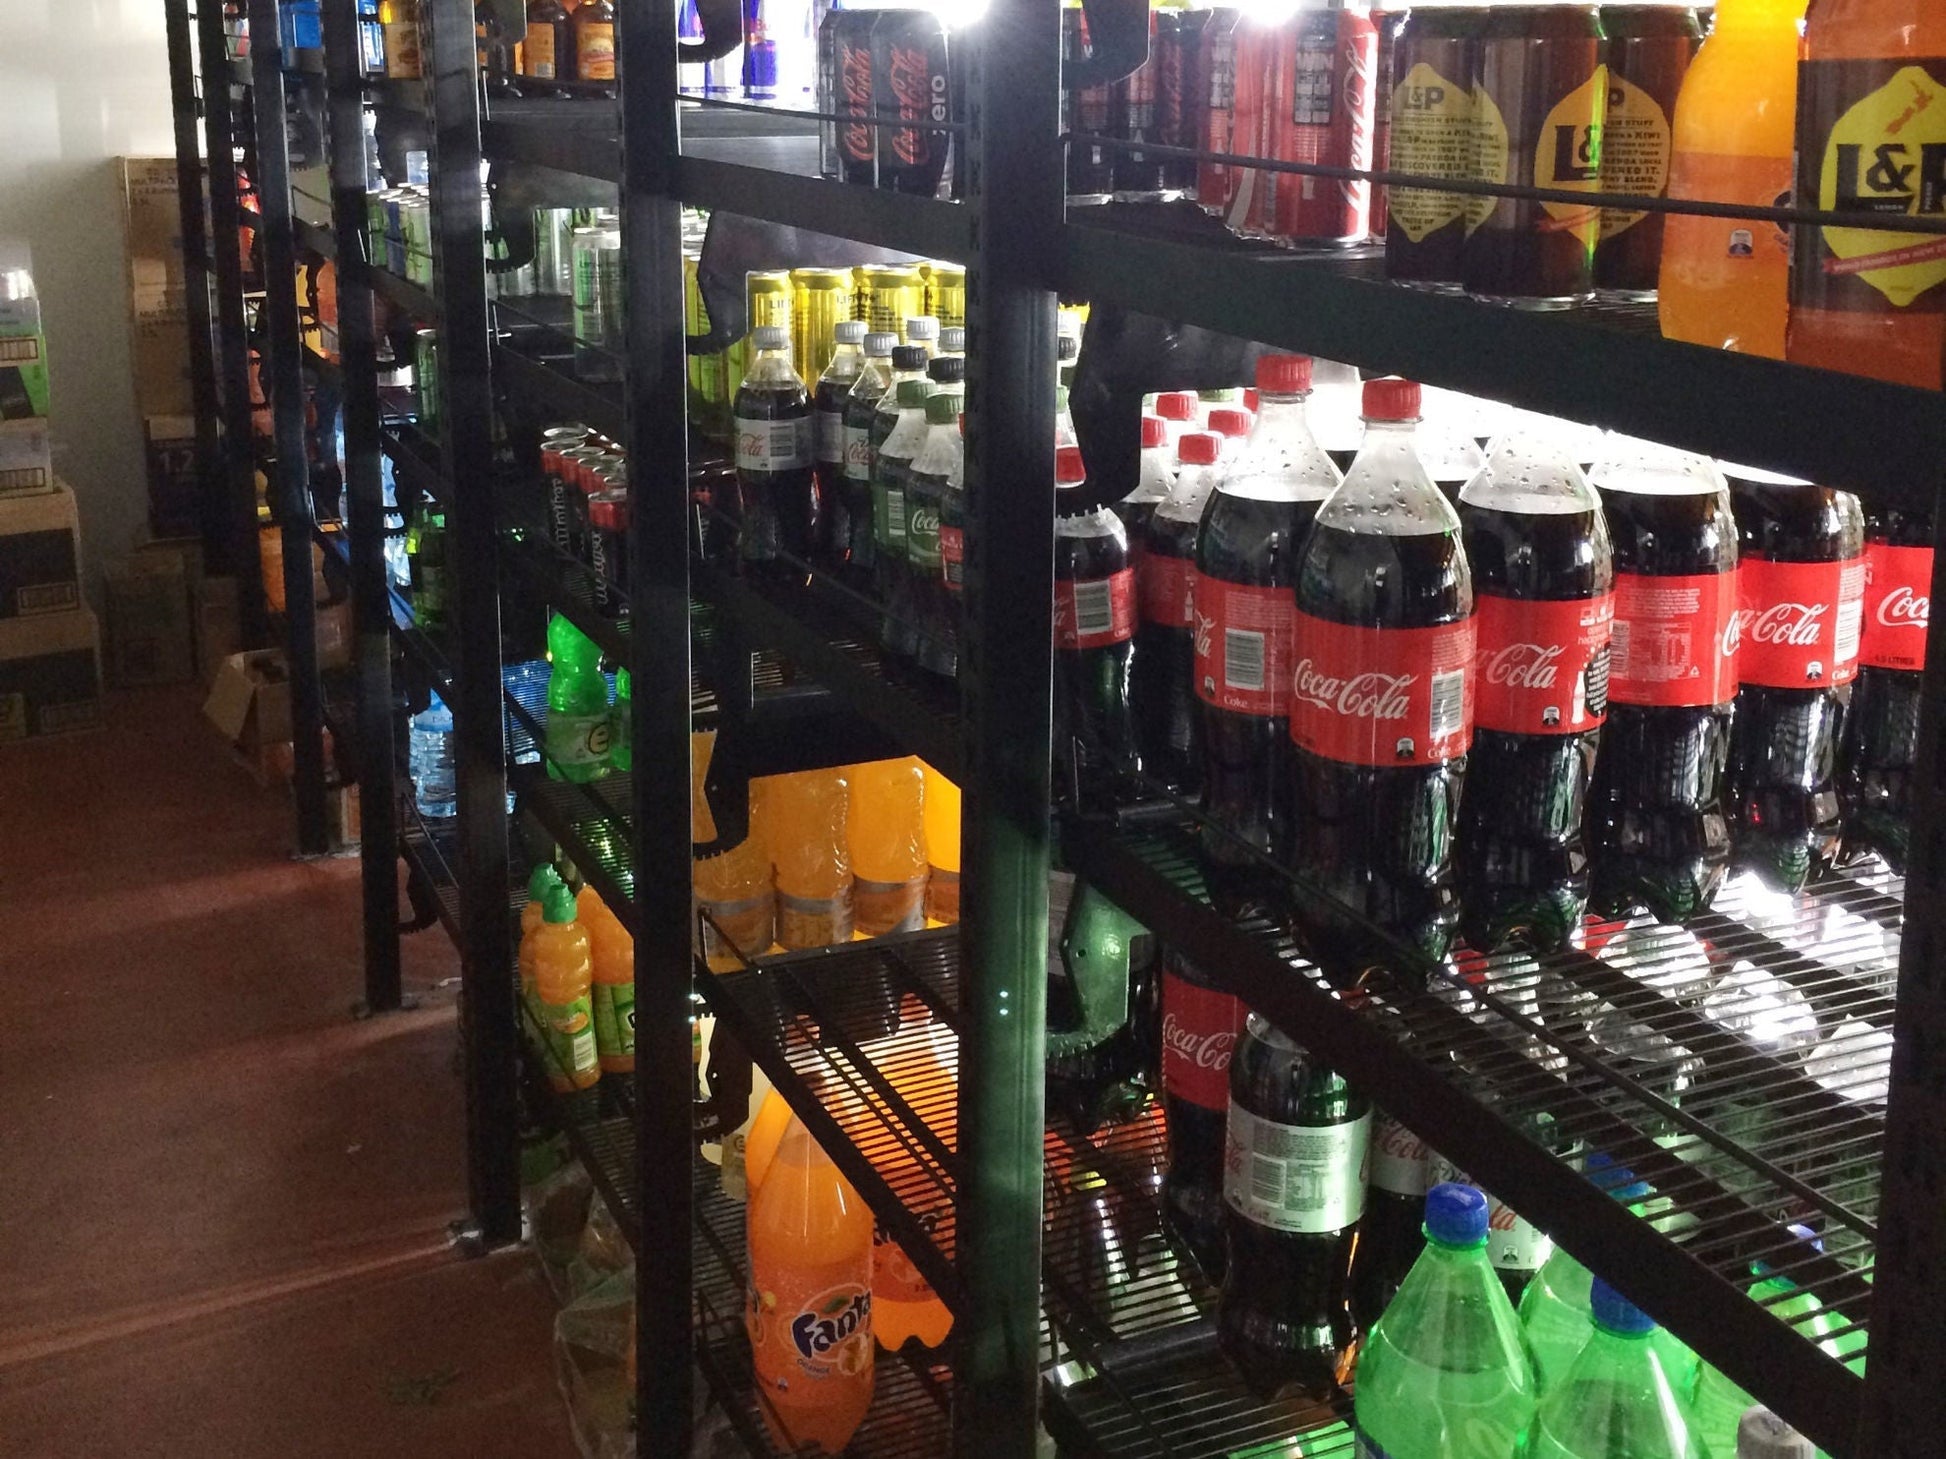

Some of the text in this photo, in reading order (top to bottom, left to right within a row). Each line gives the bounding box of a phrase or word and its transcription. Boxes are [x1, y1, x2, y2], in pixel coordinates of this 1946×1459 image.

[1402, 86, 1445, 110] L&P
[1223, 695, 1249, 708] Coke
[1294, 658, 1419, 720] Coca-Cola
[791, 1287, 872, 1359] Fanta
